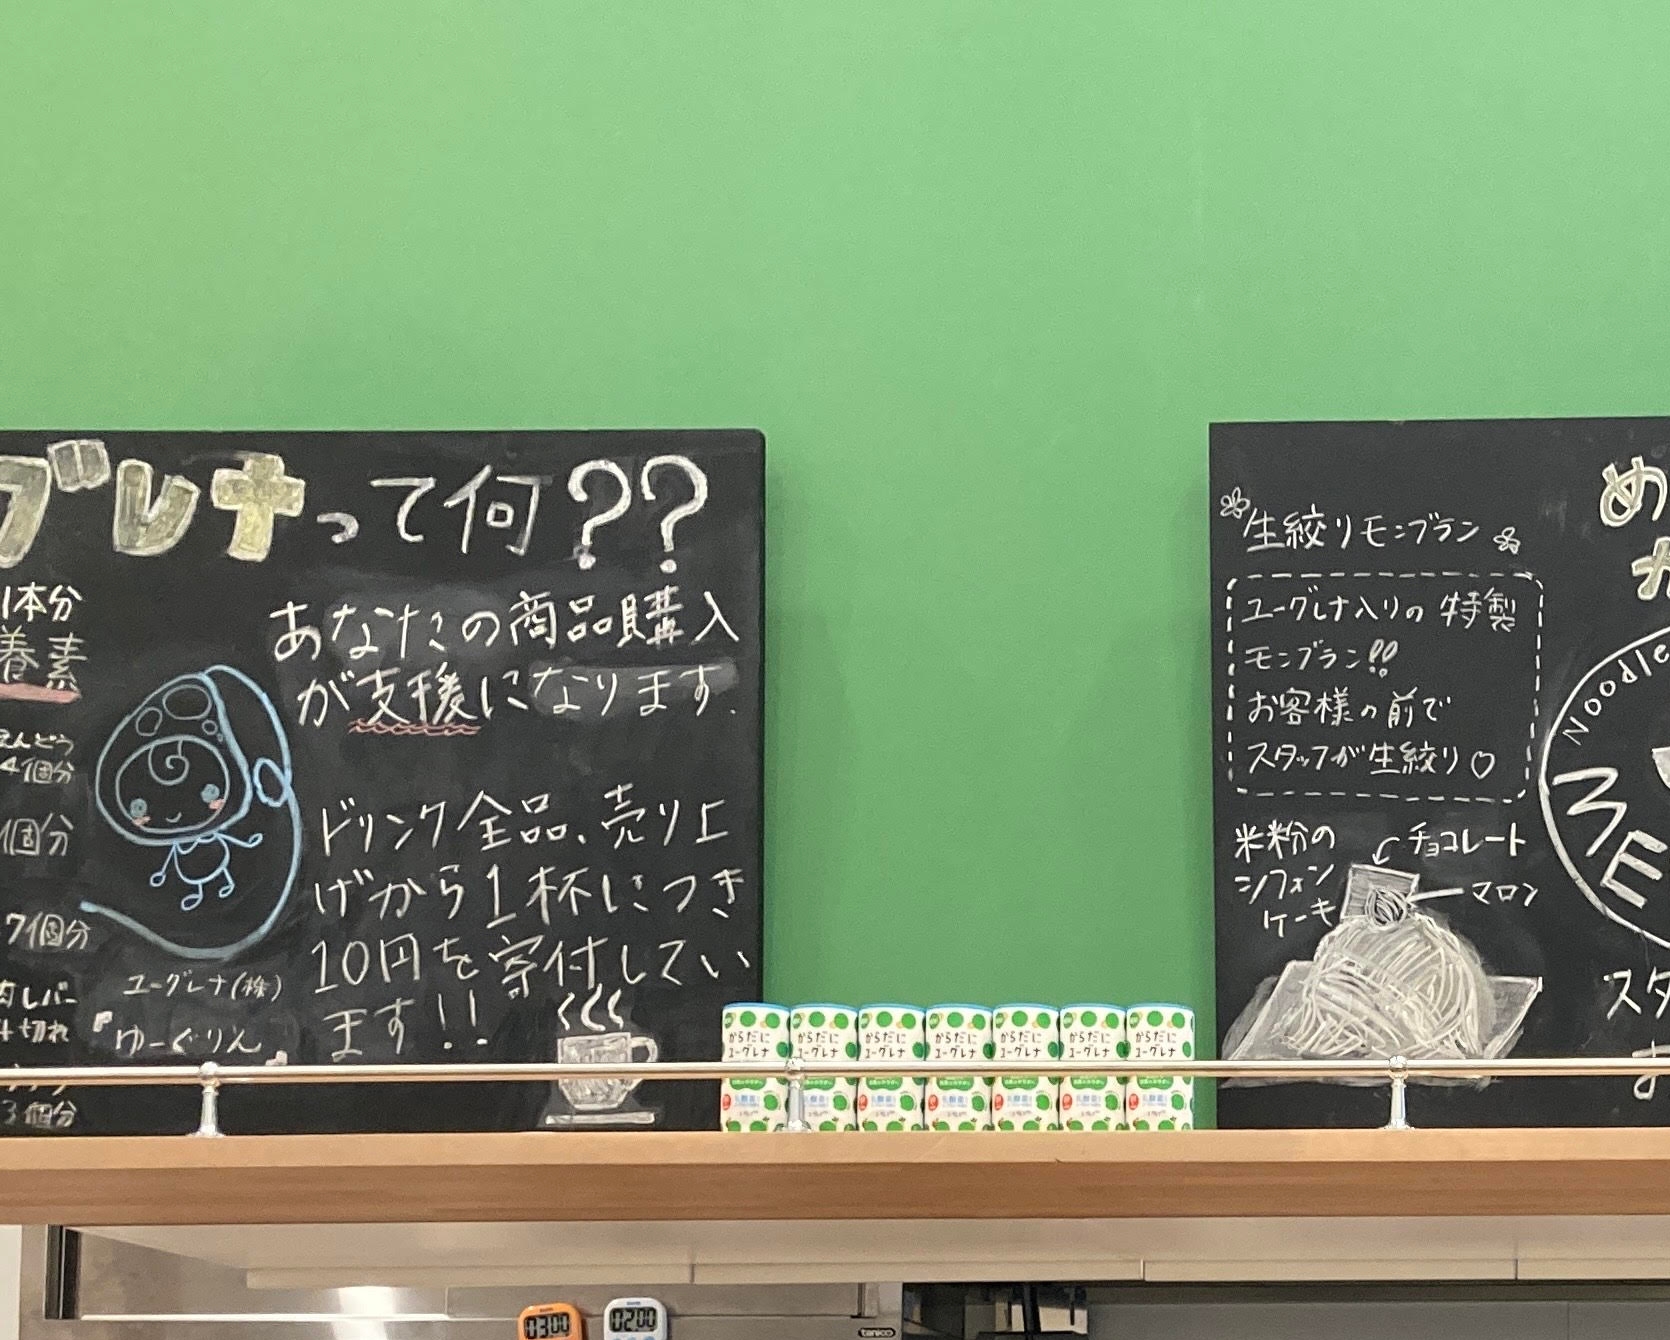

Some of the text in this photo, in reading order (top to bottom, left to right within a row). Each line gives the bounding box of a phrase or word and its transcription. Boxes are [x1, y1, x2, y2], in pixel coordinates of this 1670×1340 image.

[1242, 503, 1481, 553] 生絞りモンブラン
[269, 588, 740, 662] あなたの商品購入
[1240, 585, 1518, 633] ユーグレナ入りの特製
[1247, 686, 1454, 727] お客様の前で
[1234, 820, 1337, 865] 米粉の
[1407, 821, 1527, 858] チョコレート
[311, 863, 746, 928] げから1杯につき
[1234, 863, 1336, 905] シフォン
[1470, 882, 1540, 907] マロン
[1262, 898, 1337, 938] ケーキ
[310, 932, 751, 1000] 10円を寄付してい
